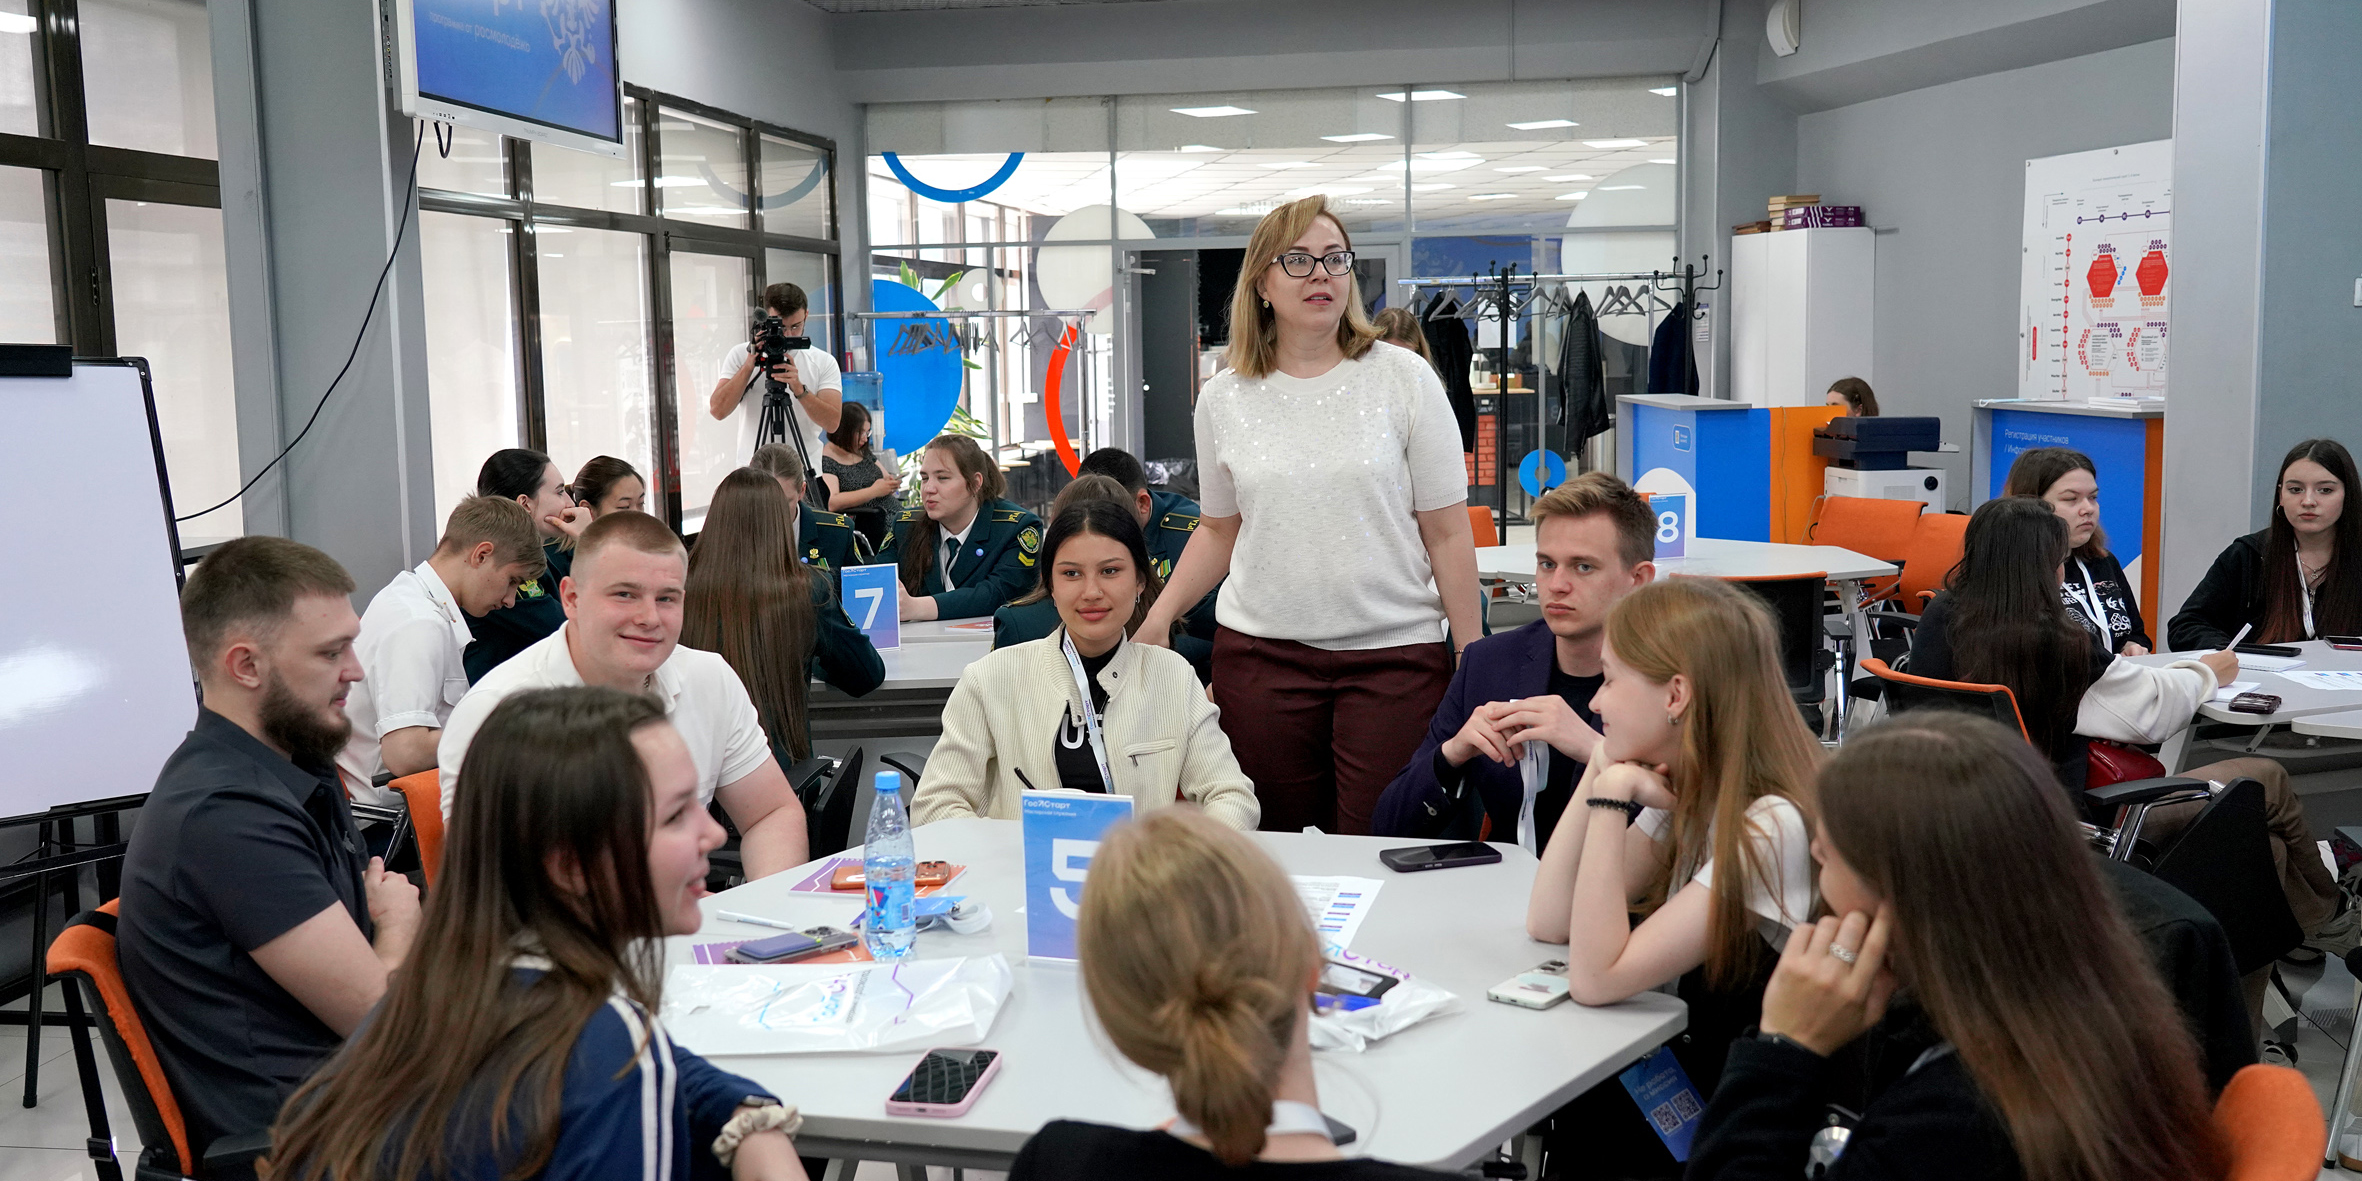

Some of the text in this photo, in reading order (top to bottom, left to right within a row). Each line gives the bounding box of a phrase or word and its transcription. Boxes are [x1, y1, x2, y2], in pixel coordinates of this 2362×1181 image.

[2004, 428, 2069, 445] Регистрация участников
[1656, 510, 1679, 544] 8
[855, 587, 884, 630] 7
[1050, 838, 1102, 921] 5
